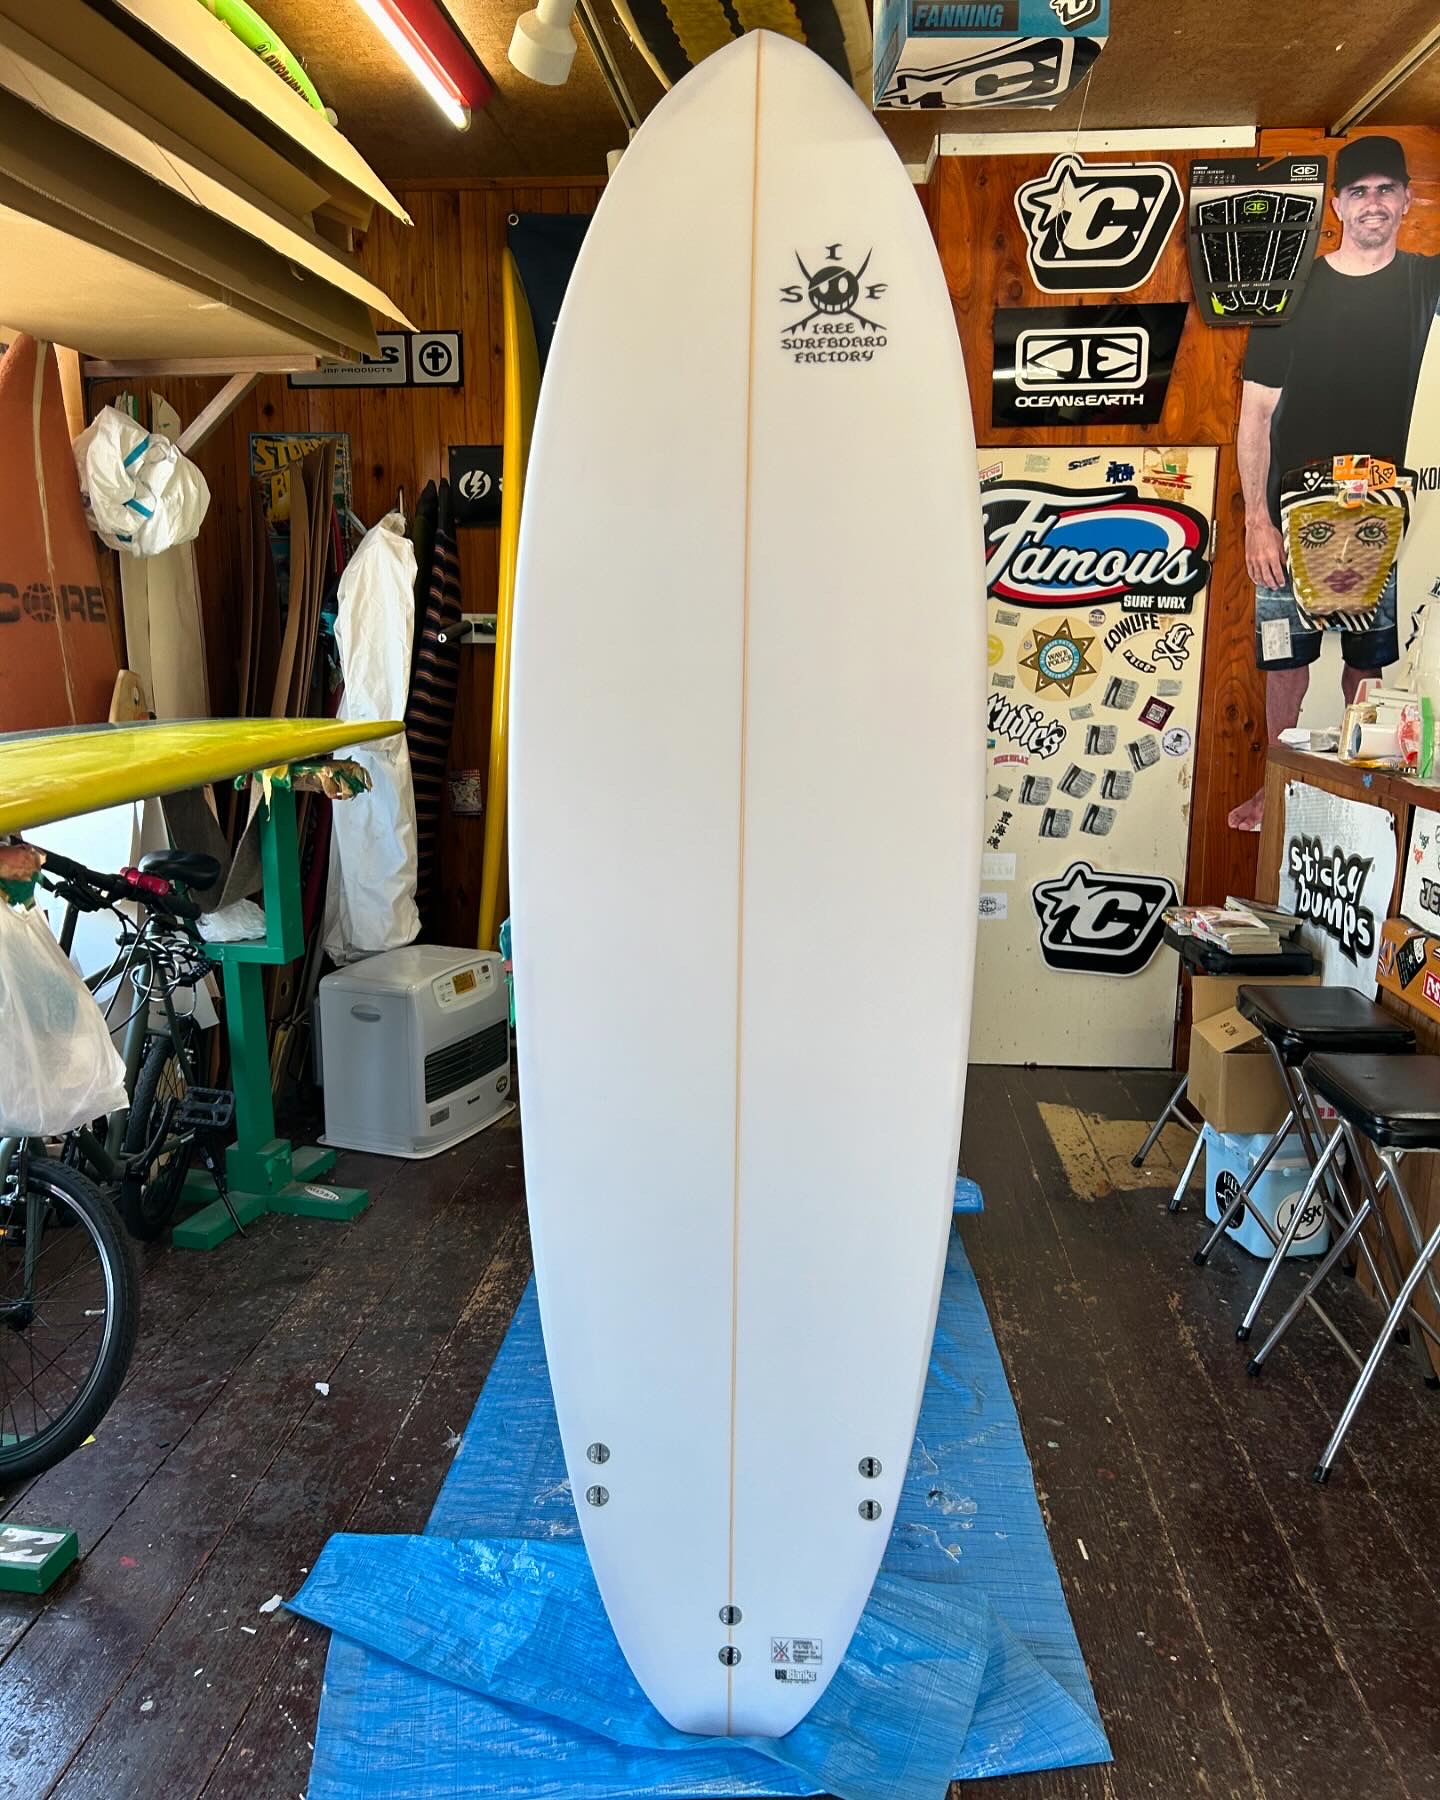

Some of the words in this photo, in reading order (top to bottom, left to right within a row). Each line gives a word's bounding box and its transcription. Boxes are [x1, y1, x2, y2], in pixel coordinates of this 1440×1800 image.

[913, 4, 1005, 29] FANNING
[781, 335, 888, 350] SURFBOARD
[794, 350, 875, 364] FACTORY
[1014, 393, 1145, 407] OCEAN&EARTH
[983, 488, 1198, 595] Famous
[1123, 595, 1154, 609] SURF
[1157, 596, 1186, 610] WAX
[1104, 613, 1161, 653] LOWLIFE
[1047, 649, 1068, 661] WAVE
[1048, 654, 1072, 667] POLICE
[1290, 843, 1366, 904] sticky
[1420, 878, 1440, 916] JE
[1298, 876, 1371, 950] bumps
